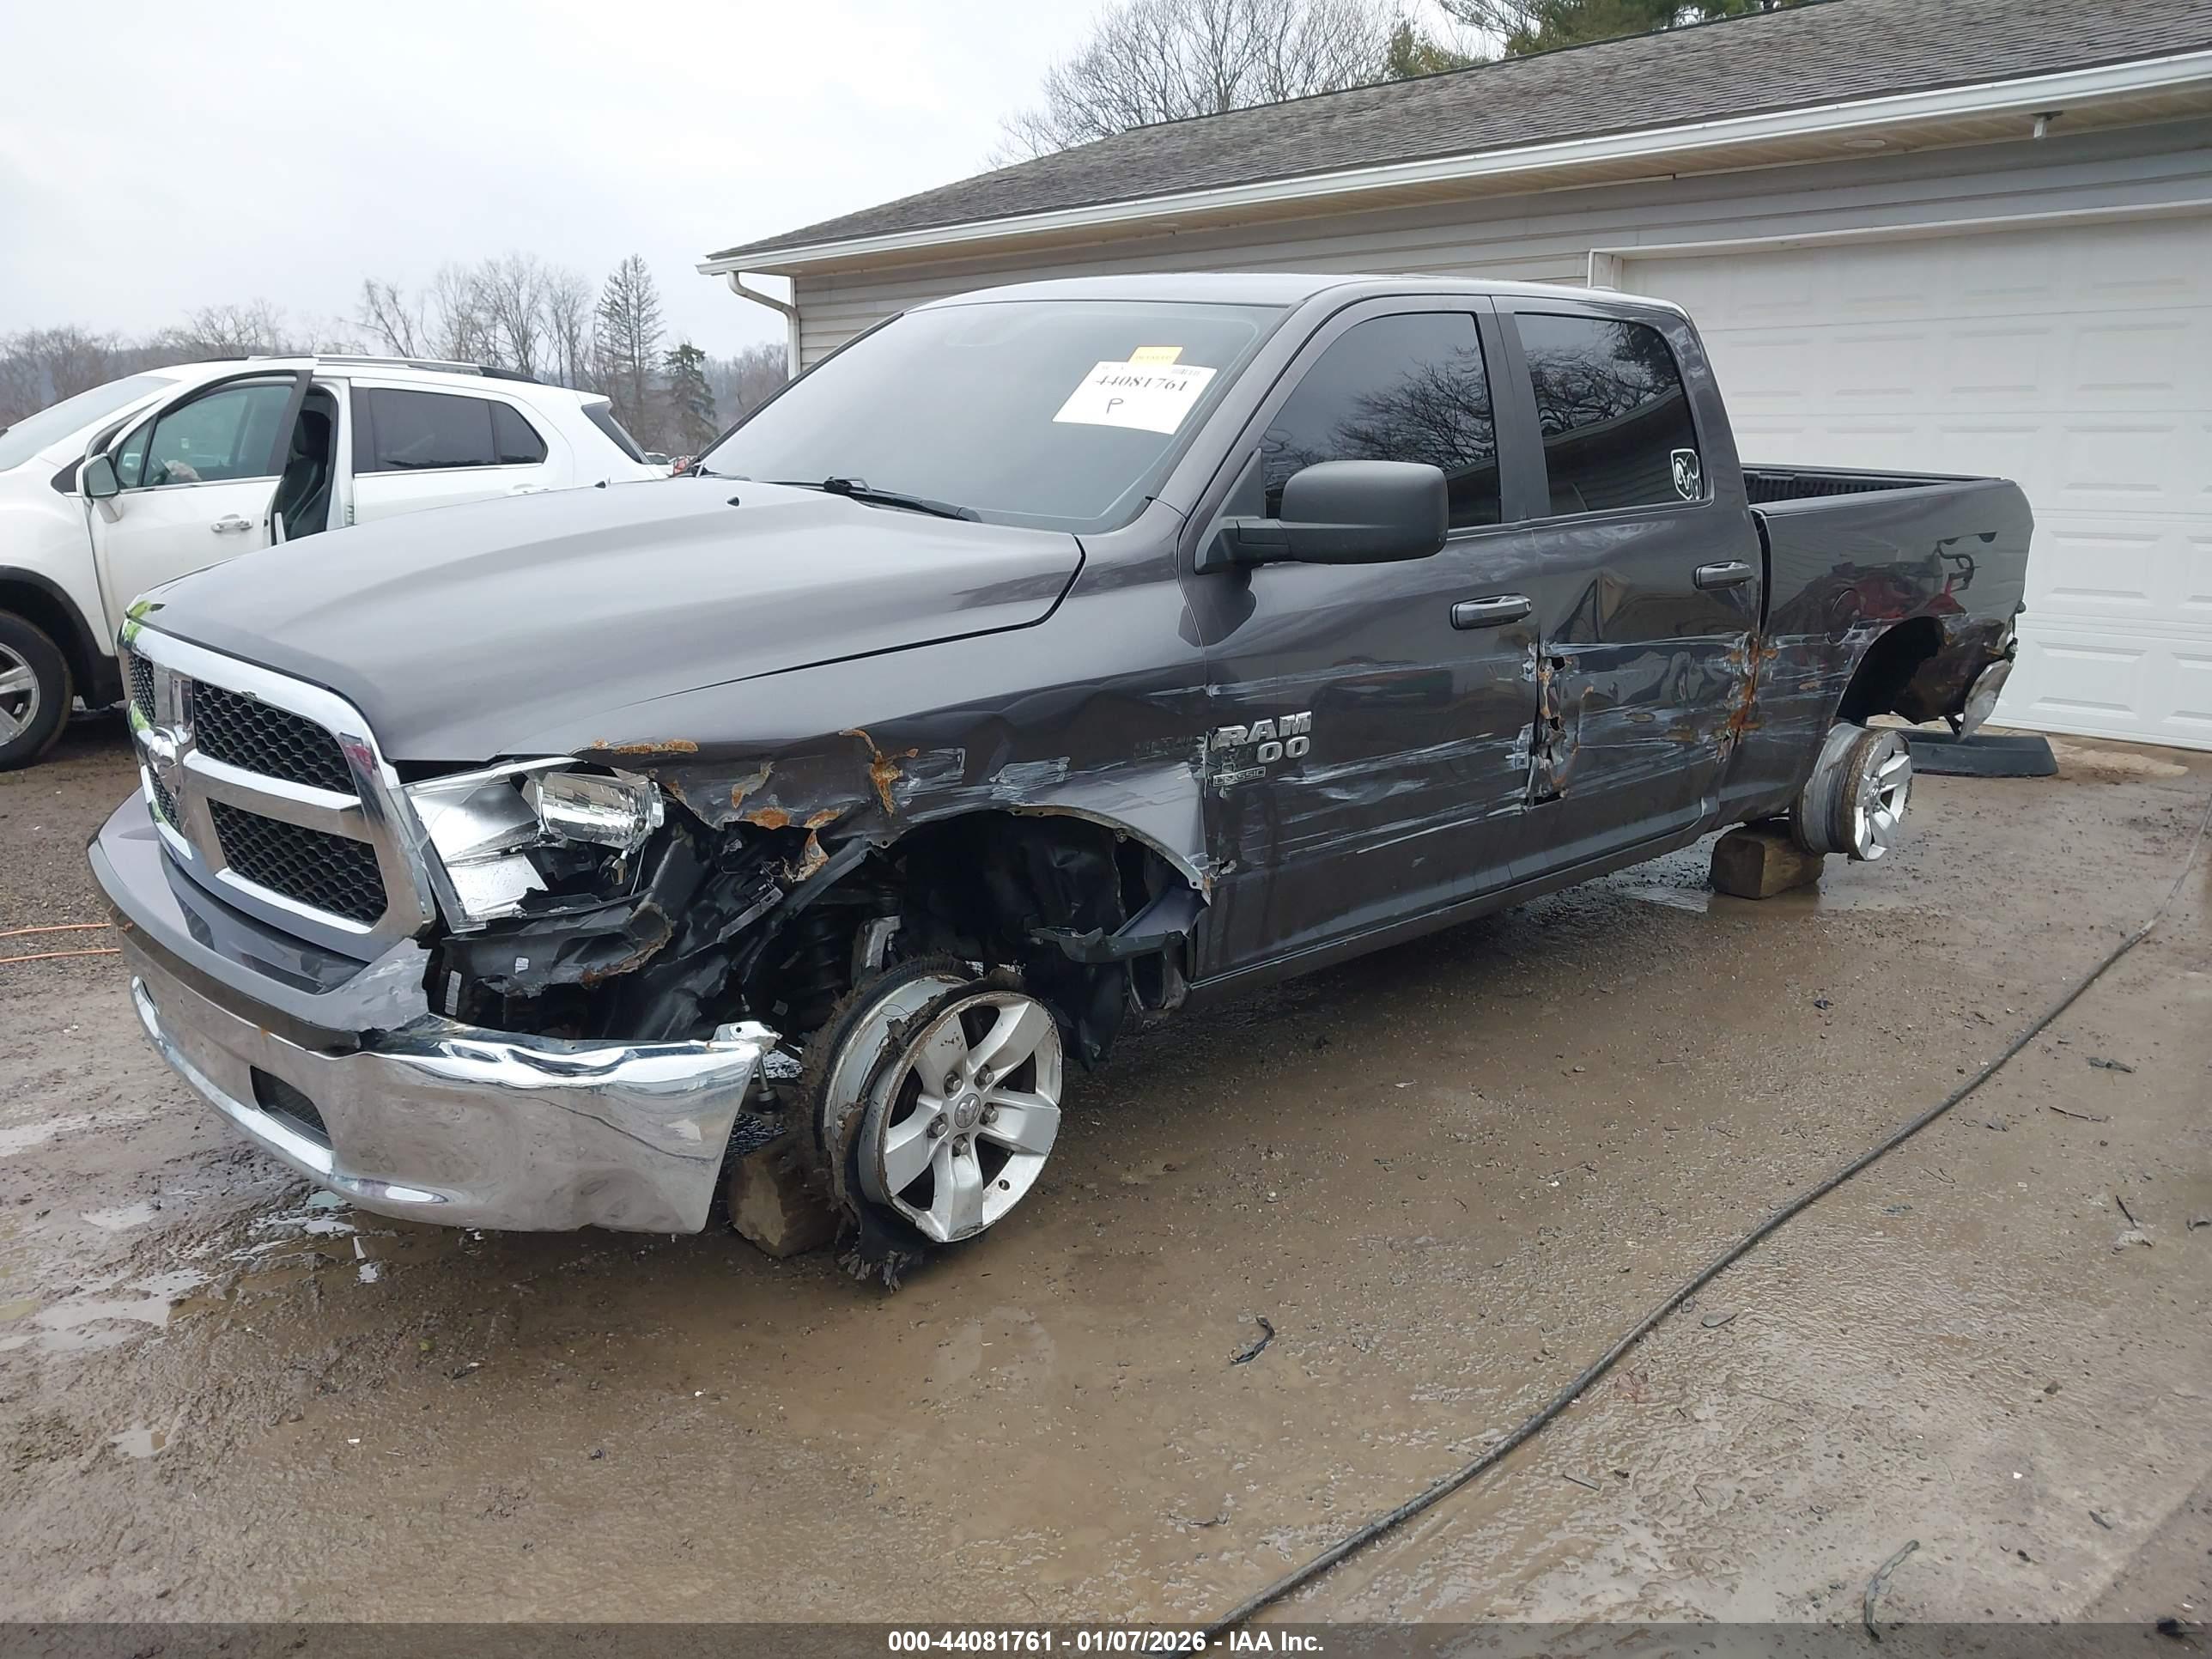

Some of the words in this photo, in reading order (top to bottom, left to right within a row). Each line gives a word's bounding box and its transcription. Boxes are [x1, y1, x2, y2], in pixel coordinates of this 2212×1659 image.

[1096, 375, 1188, 391] 44081761
[1106, 398, 1124, 414] P
[1212, 711, 1312, 751] RAM
